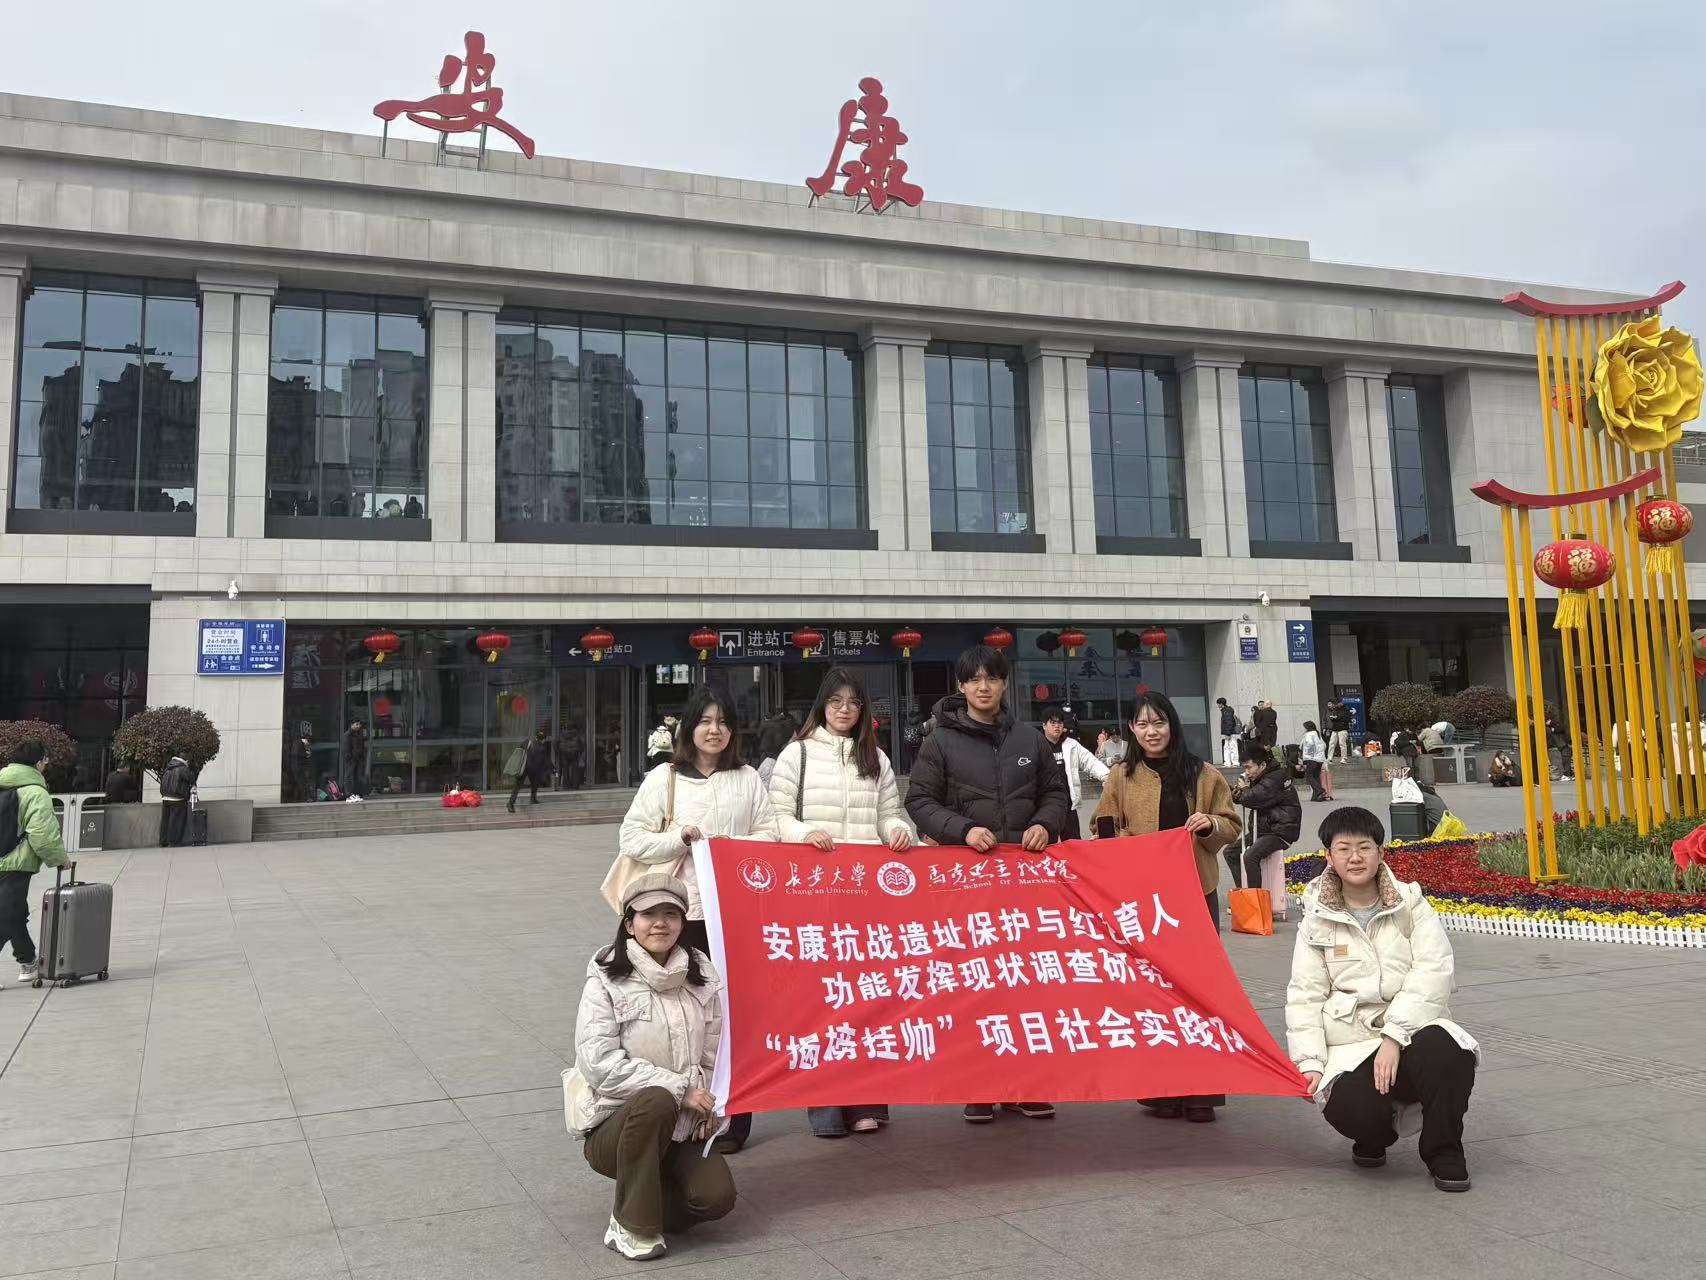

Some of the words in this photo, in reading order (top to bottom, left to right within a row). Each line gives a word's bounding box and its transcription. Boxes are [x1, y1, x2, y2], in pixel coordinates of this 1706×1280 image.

[747, 629, 794, 647] 进站口
[832, 629, 880, 647] 售票处
[747, 648, 785, 657] Entrance
[832, 647, 861, 656] Tickets
[963, 881, 992, 890] School
[785, 888, 824, 896] Chang'an
[826, 887, 869, 896] University
